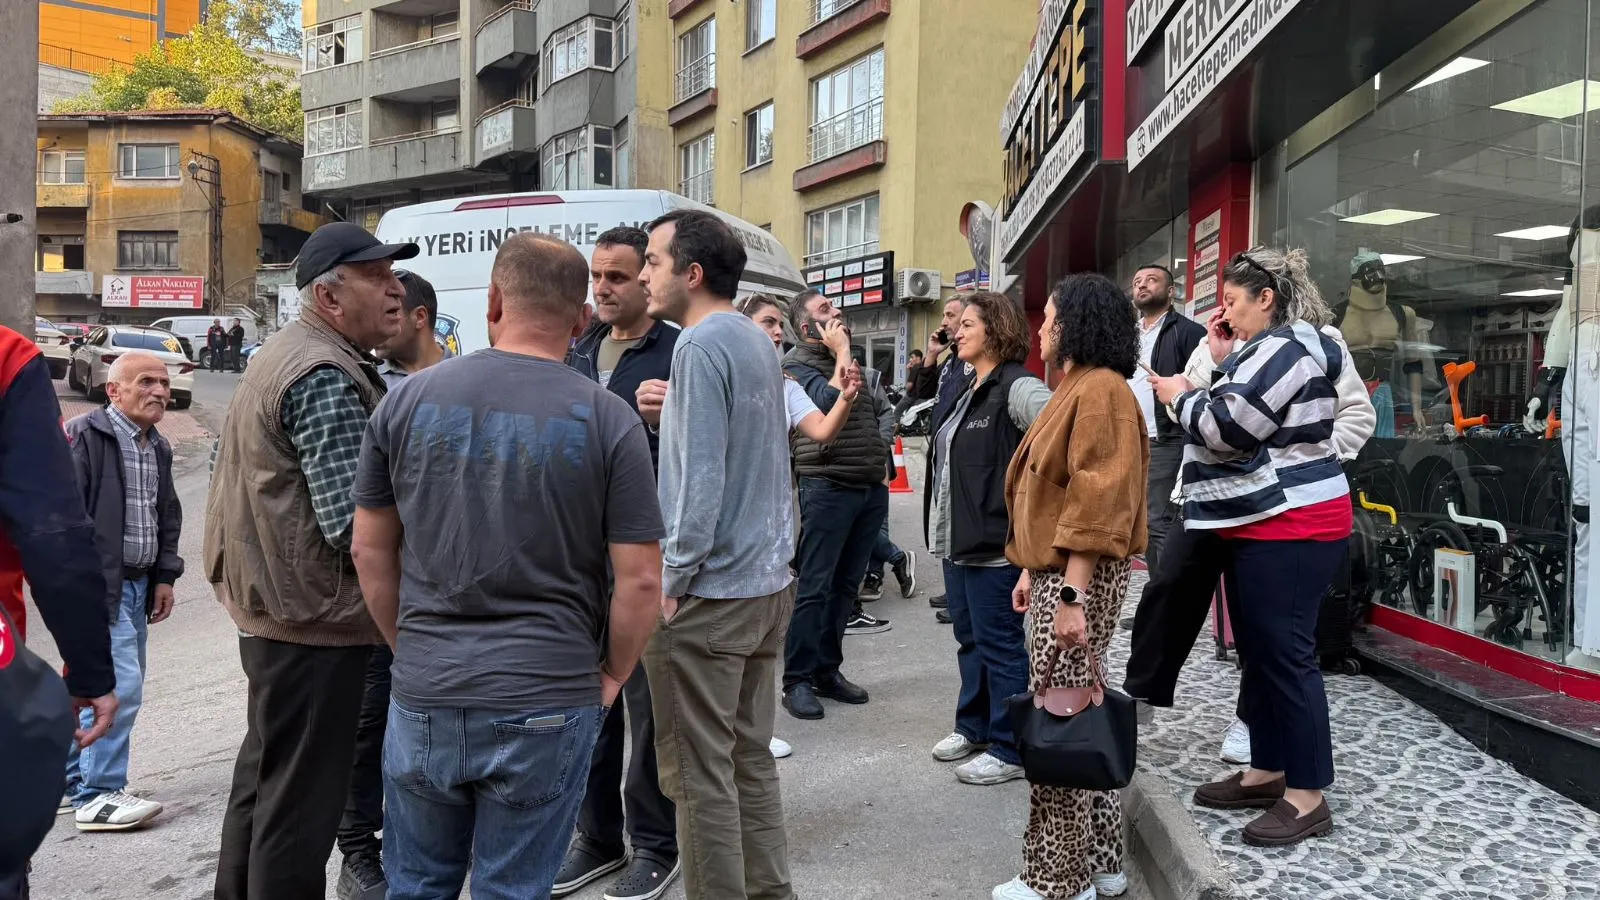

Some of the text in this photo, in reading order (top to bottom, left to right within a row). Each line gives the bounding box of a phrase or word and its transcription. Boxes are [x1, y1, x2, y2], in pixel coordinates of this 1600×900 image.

[1002, 0, 1085, 220] HACETTEPE
[1147, 0, 1288, 143] www.hacettepemedika
[136, 278, 161, 288] ALKAN
[967, 418, 989, 430] AFAD
